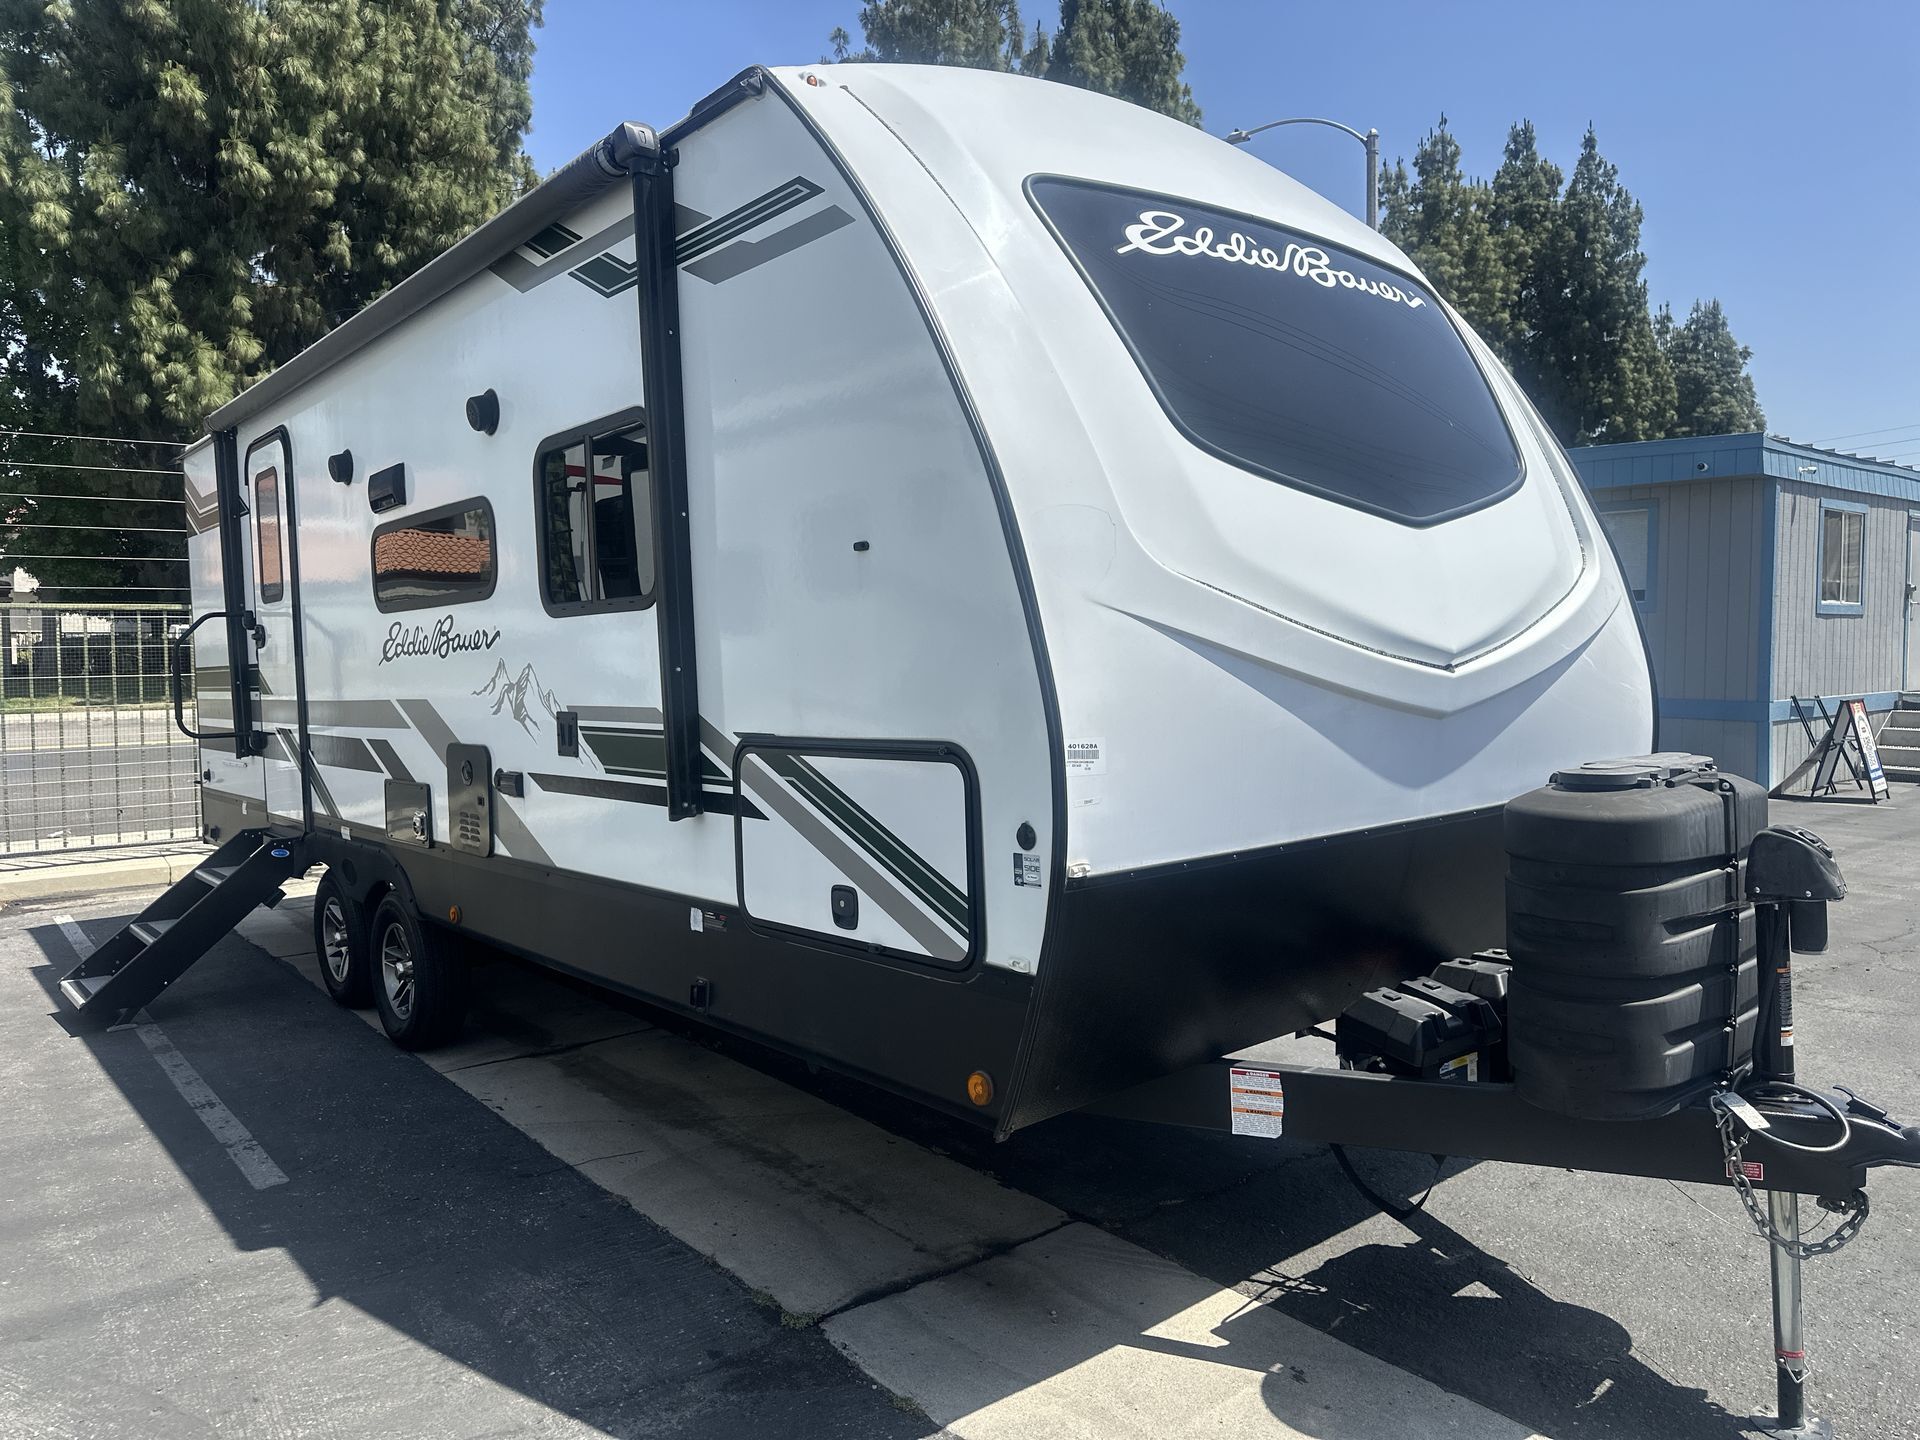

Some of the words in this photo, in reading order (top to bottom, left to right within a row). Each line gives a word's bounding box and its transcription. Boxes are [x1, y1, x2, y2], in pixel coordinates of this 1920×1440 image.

[1117, 210, 1287, 272] Eddie
[1284, 243, 1426, 308] Bauer
[379, 621, 431, 665] Eddie
[431, 614, 500, 659] Bauer
